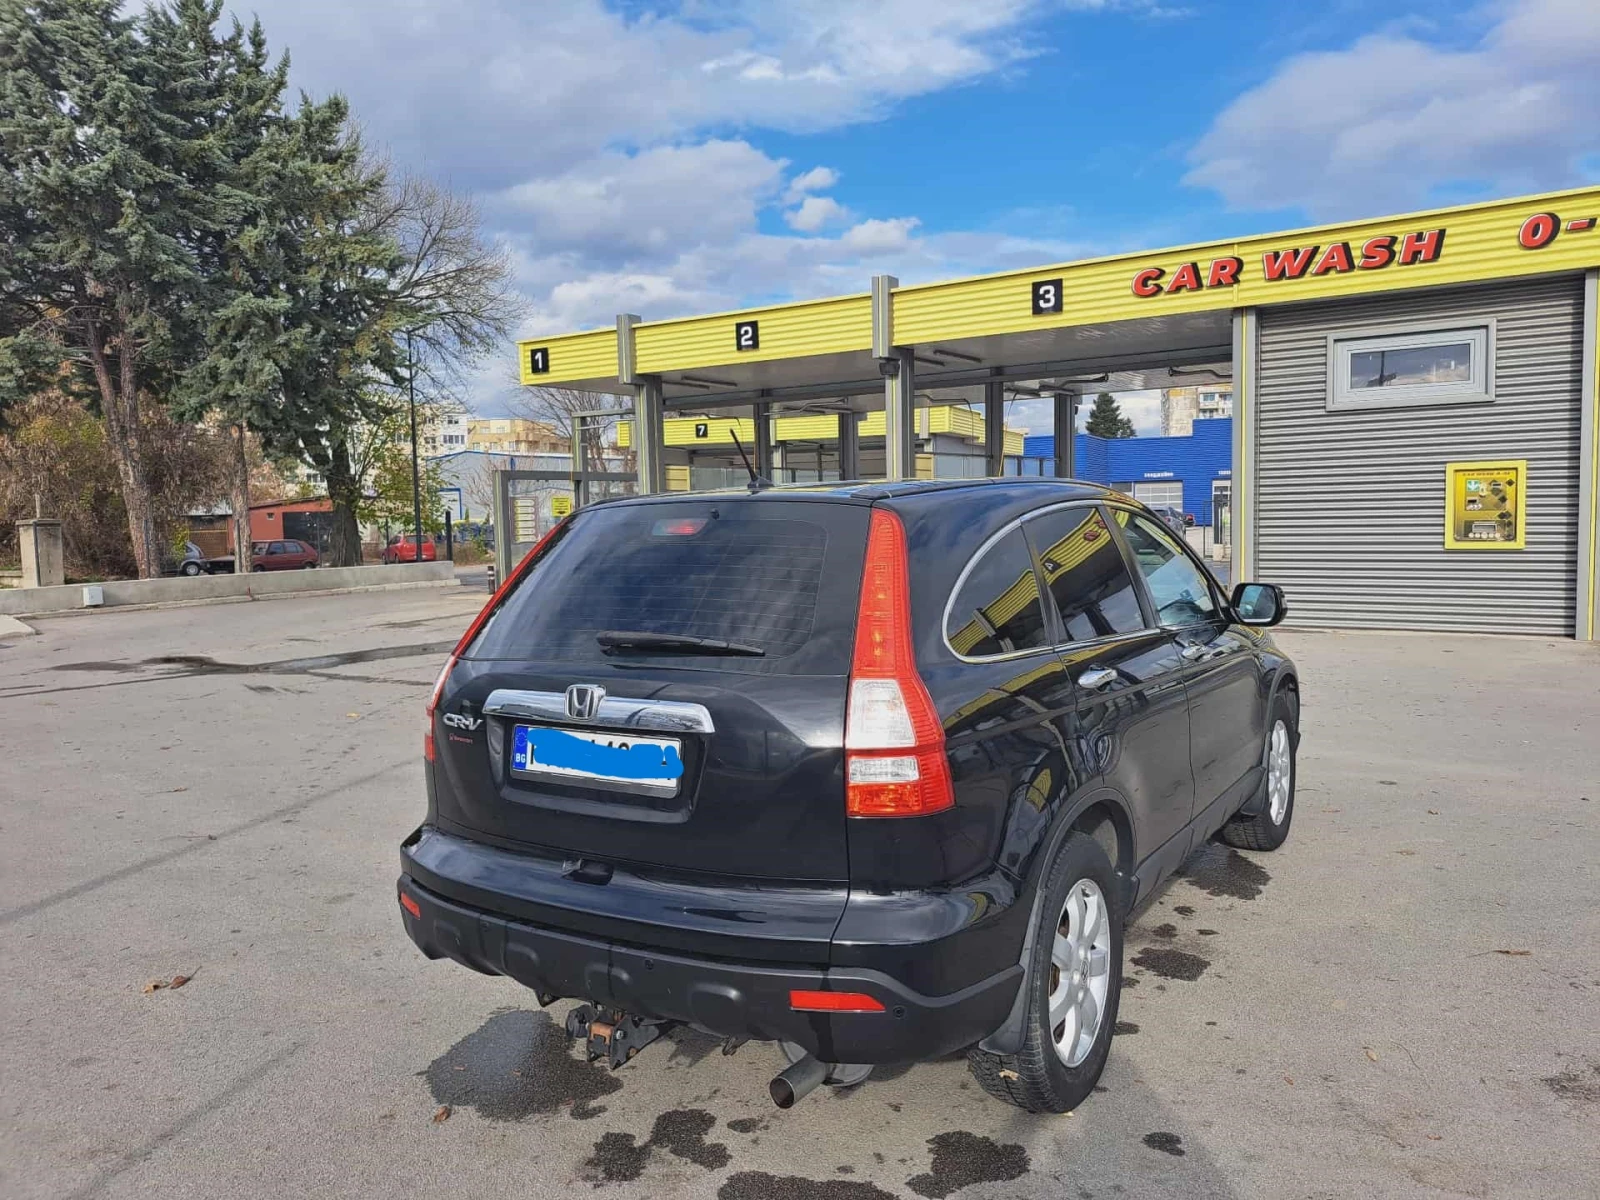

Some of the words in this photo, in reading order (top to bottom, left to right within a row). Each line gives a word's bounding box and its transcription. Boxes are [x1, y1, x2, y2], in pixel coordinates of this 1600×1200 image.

[1131, 256, 1243, 298] CAR
[1262, 228, 1446, 281] WASH
[1039, 285, 1055, 308] 3
[740, 326, 753, 346] 2
[534, 352, 542, 369] 1
[698, 425, 706, 436] 7
[515, 753, 526, 763] BG
